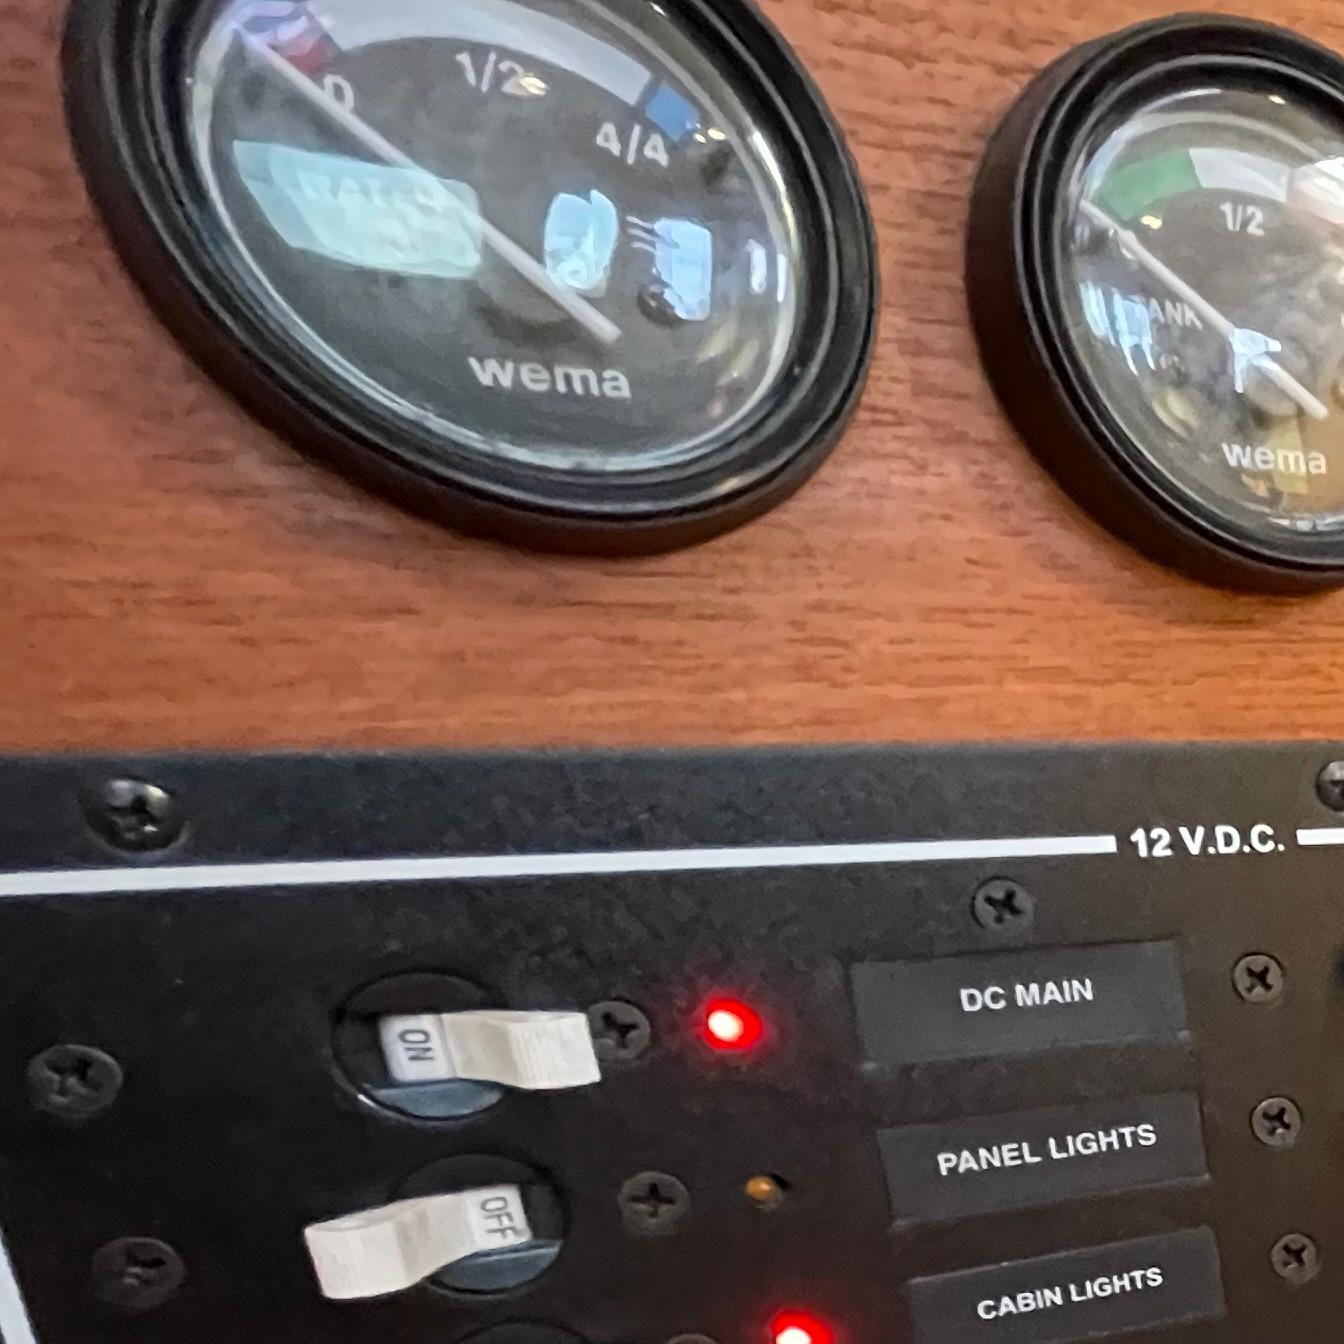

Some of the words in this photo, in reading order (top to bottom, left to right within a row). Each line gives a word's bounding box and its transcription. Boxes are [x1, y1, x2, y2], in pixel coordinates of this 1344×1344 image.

[597, 124, 670, 169] 4/4
[1219, 202, 1265, 237] 1/2
[467, 352, 632, 400] wema
[1222, 441, 1328, 476] wema
[1130, 828, 1175, 858] 12
[1179, 825, 1286, 856] V.D.C.
[960, 984, 1008, 1012] DC
[1014, 978, 1095, 1007] MAIN
[400, 1026, 431, 1064] ON
[937, 1137, 1040, 1177] PANEL
[1046, 1123, 1158, 1160] LIGHTS
[479, 1196, 517, 1242] OFF
[976, 1284, 1063, 1320] CABIN
[1070, 1266, 1164, 1303] LIGHTS
